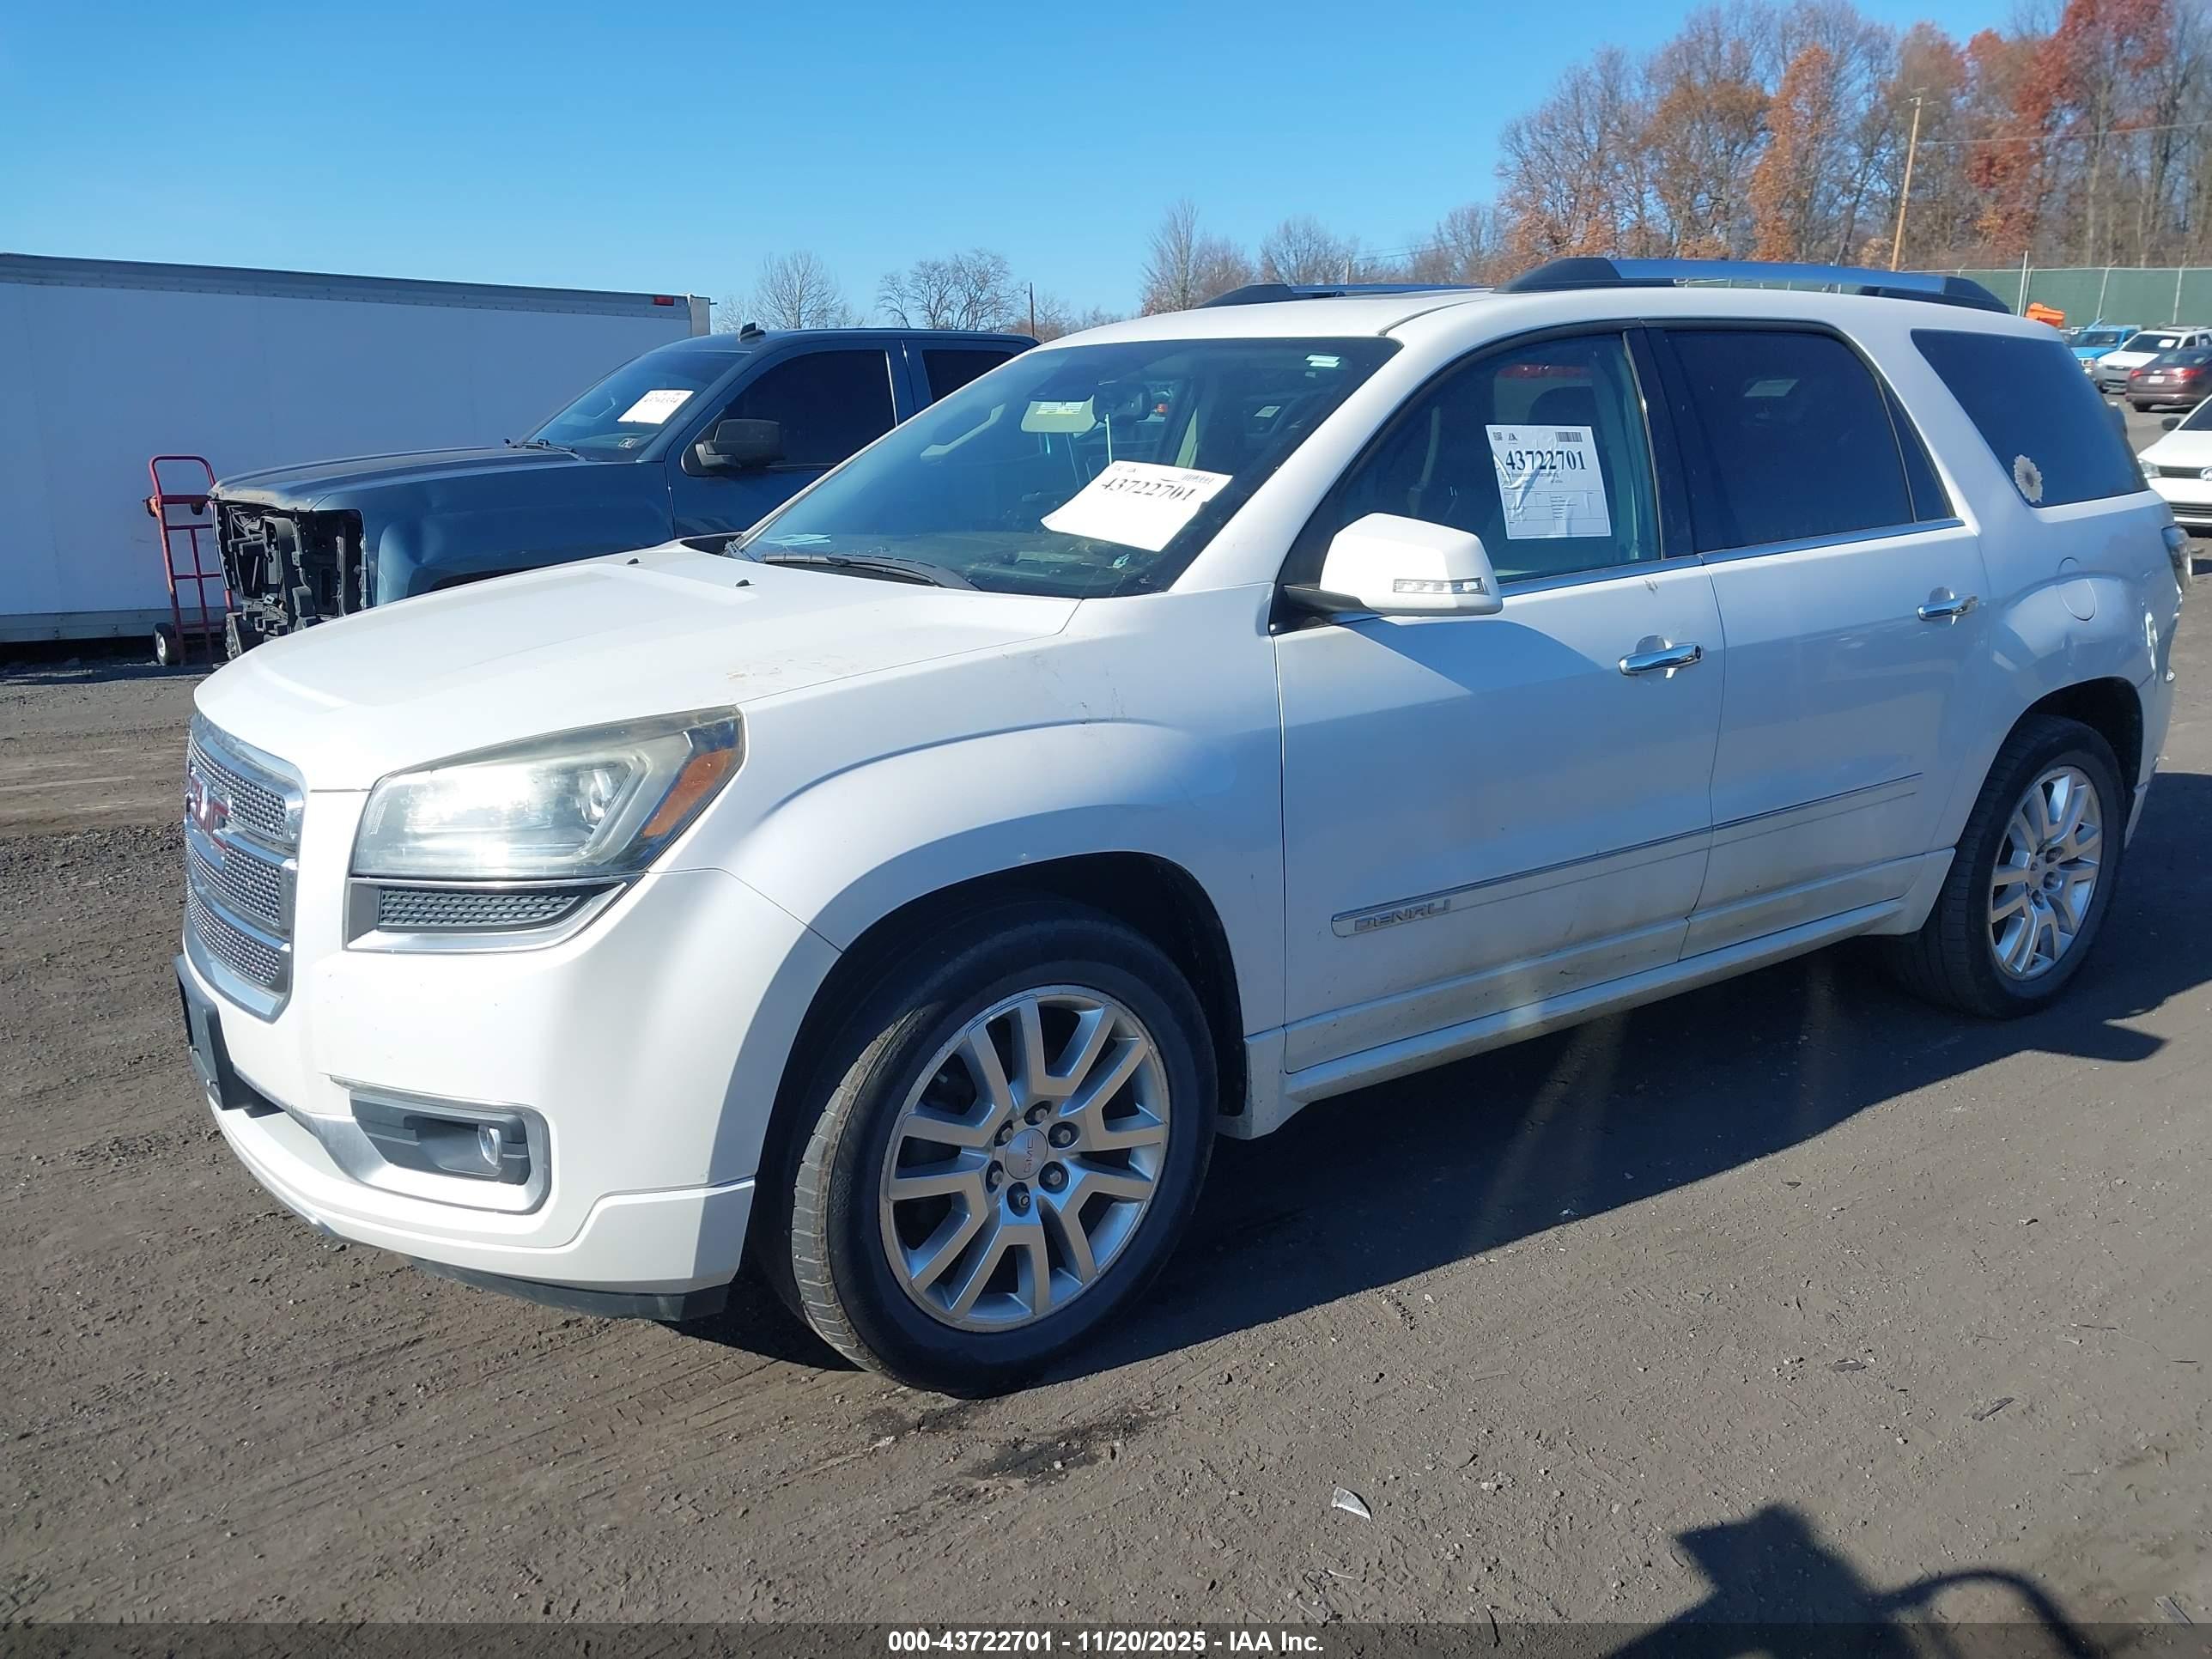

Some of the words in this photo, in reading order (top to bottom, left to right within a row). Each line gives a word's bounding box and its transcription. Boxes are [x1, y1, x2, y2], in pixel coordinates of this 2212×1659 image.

[1505, 450, 1587, 471] 43722701
[1101, 477, 1197, 501] 43722701
[1354, 899, 1451, 932] DENALI
[1024, 1135, 1034, 1174] GMC
